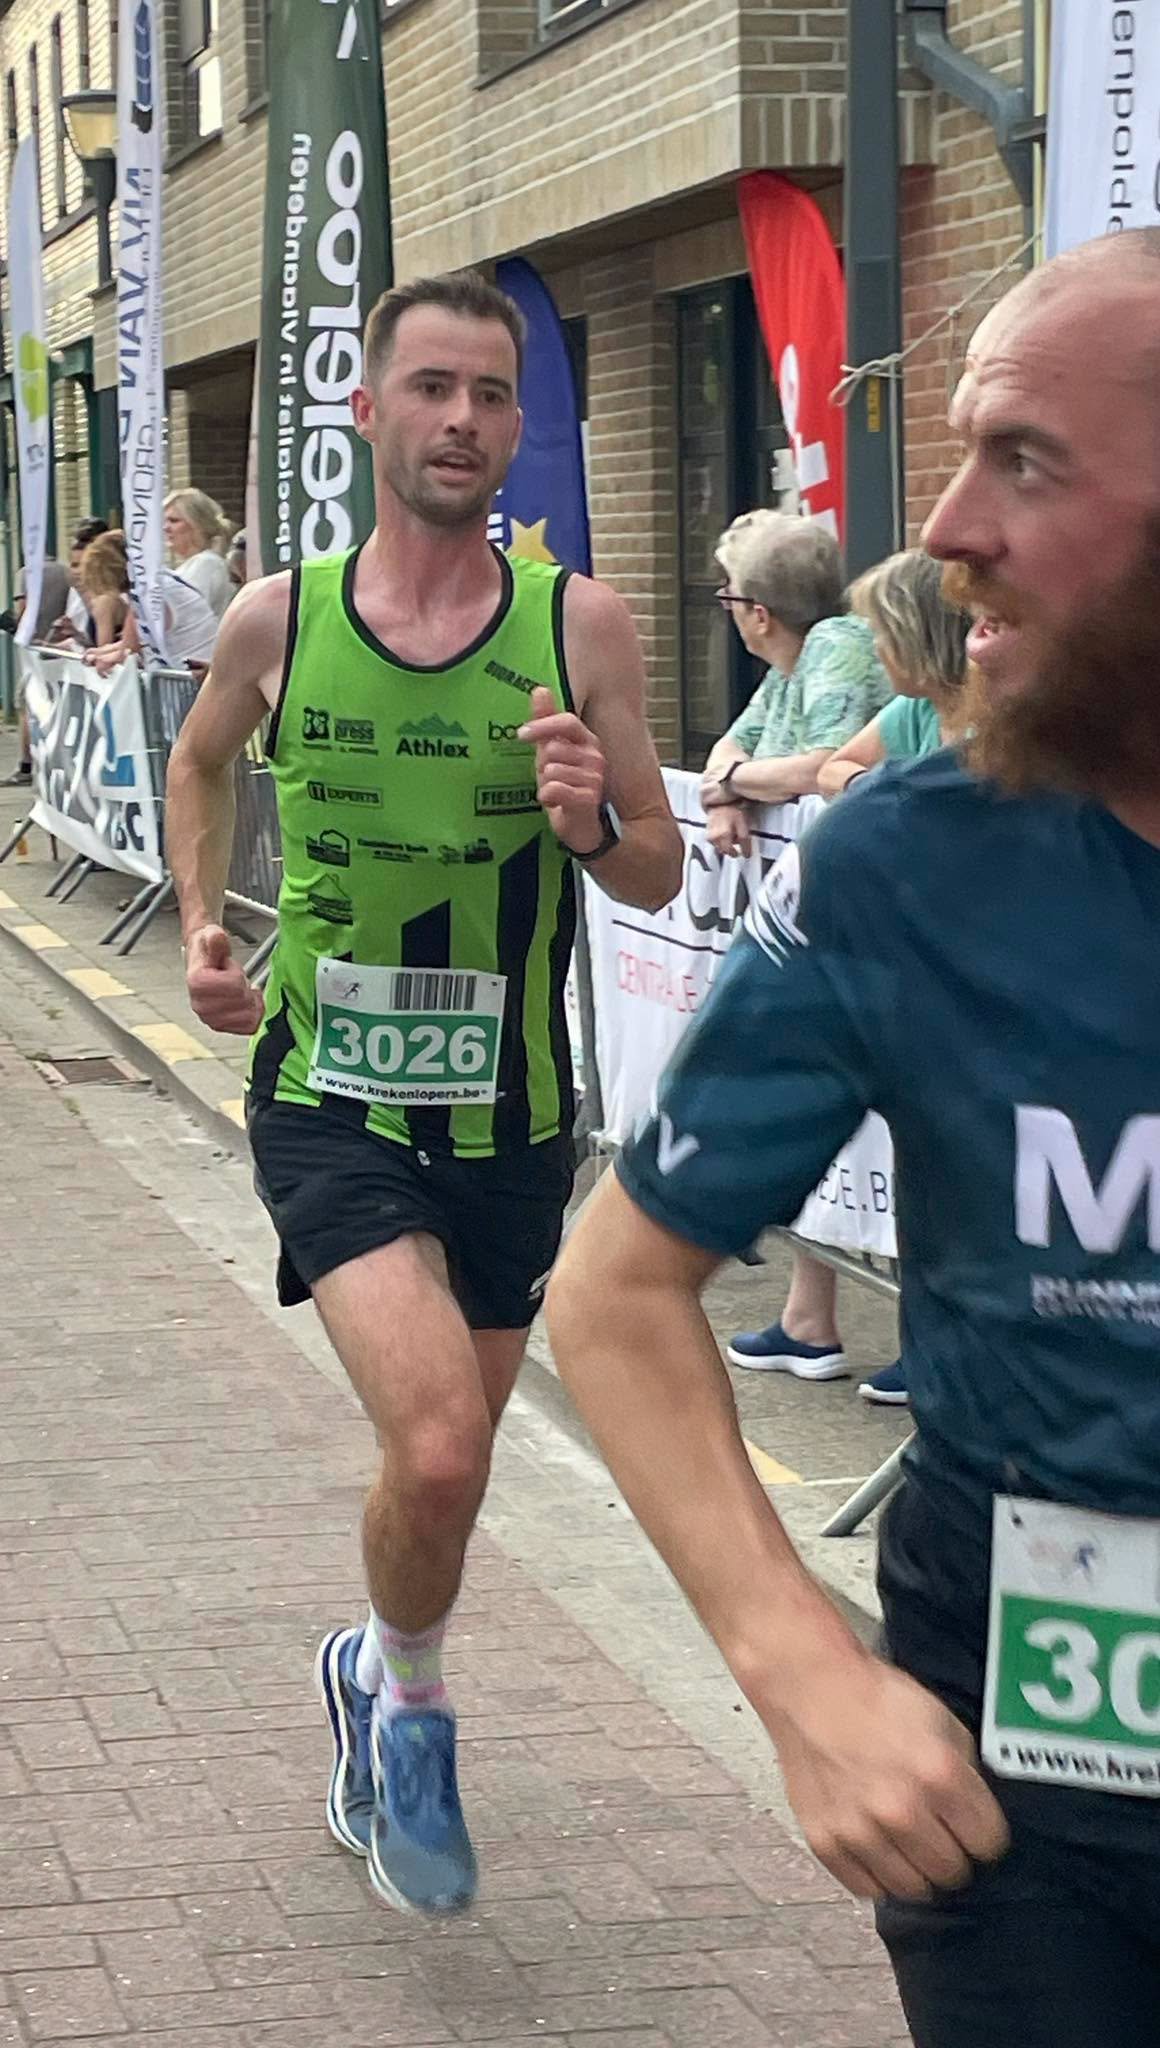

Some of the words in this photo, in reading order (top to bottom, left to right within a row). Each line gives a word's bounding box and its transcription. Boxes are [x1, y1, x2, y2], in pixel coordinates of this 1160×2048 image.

[396, 738, 469, 758] Athlex
[327, 1017, 487, 1075] 3026
[324, 1077, 480, 1101] www.krekenlopers.be
[1014, 1103, 1160, 1254] M
[1019, 1617, 1160, 1736] 30
